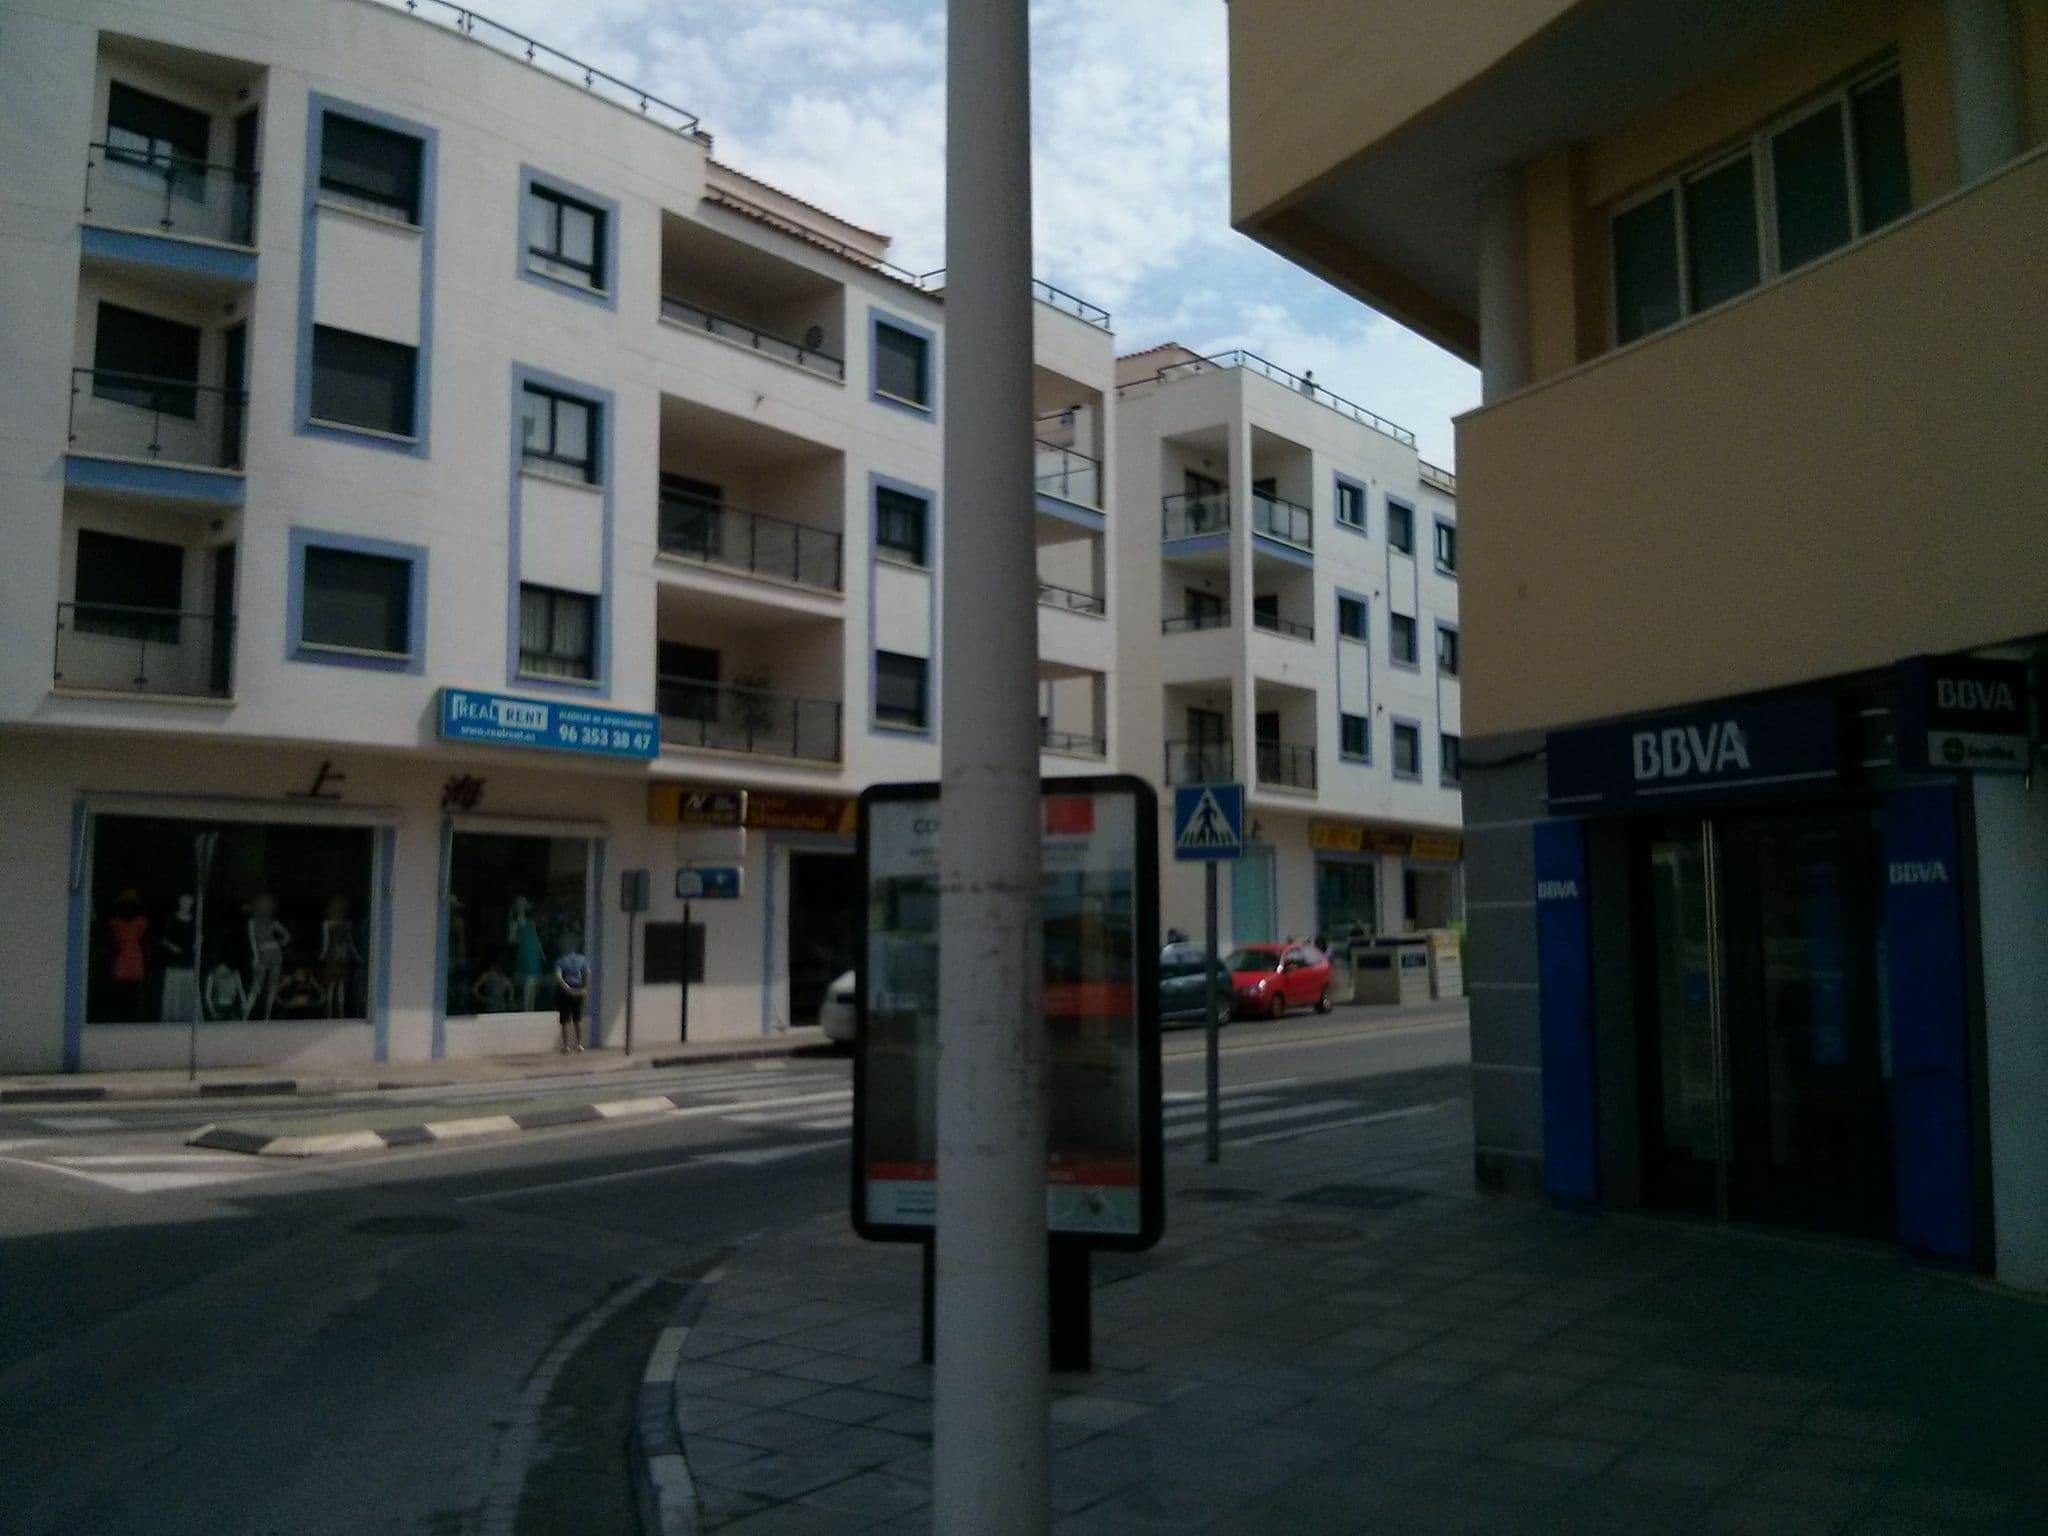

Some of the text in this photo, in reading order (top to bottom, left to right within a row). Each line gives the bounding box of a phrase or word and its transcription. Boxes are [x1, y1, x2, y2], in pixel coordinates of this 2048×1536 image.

[1937, 678, 2016, 712] BBVA
[452, 693, 543, 726] REAL RENT
[559, 723, 578, 743] 96
[1632, 720, 1751, 781] BBVA
[1887, 861, 1950, 885] BBVA
[1537, 879, 1578, 901] BBVA
